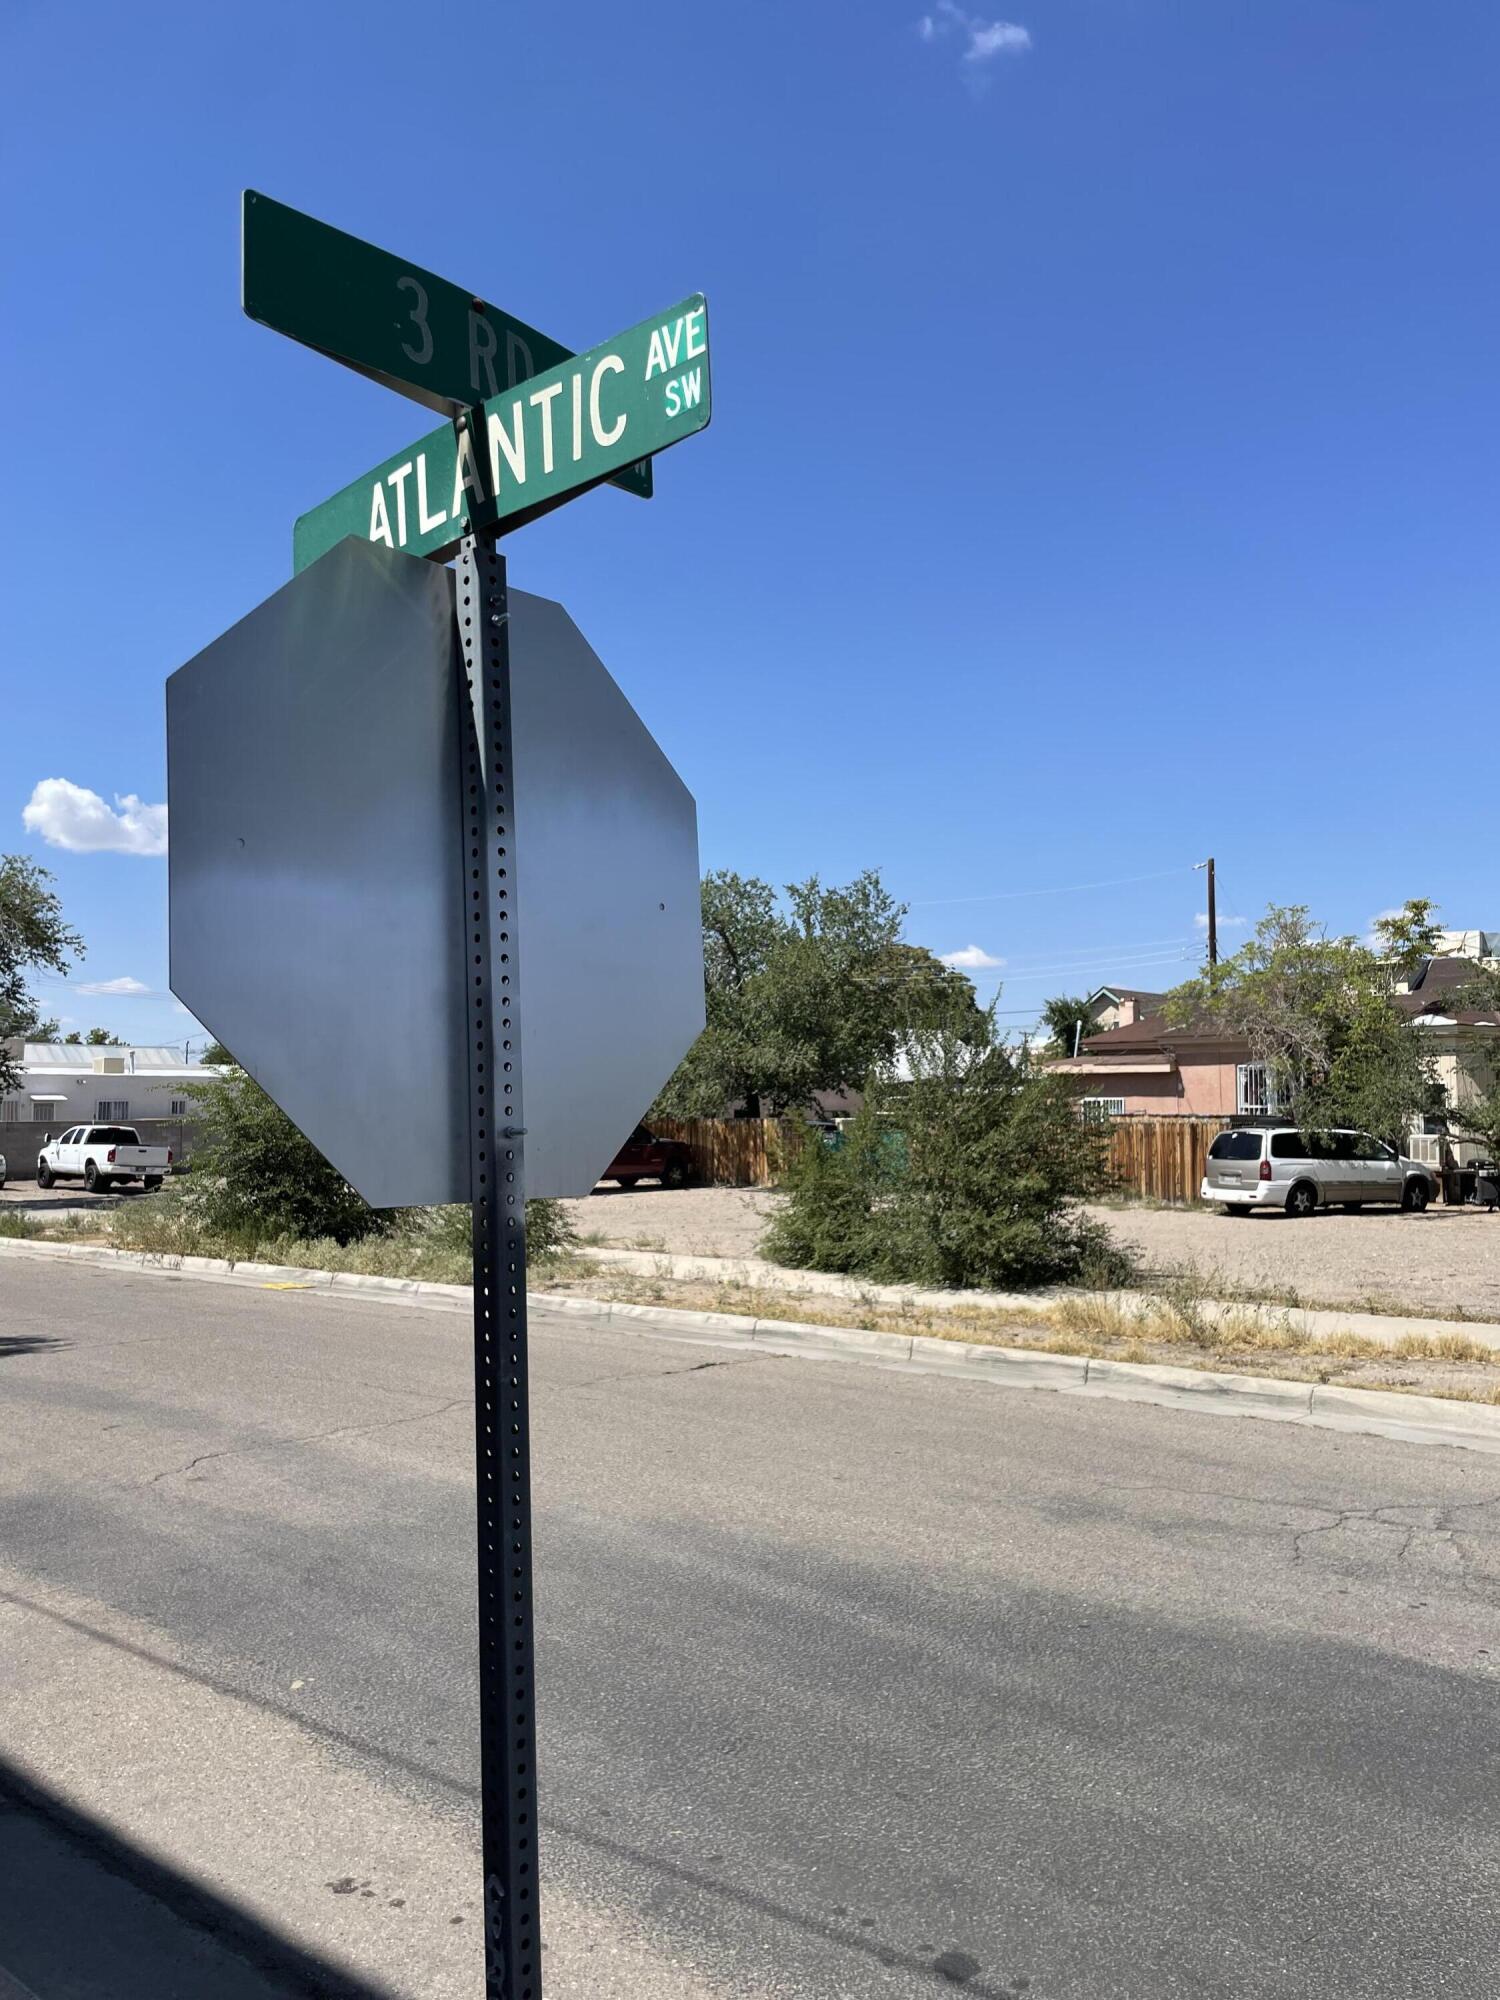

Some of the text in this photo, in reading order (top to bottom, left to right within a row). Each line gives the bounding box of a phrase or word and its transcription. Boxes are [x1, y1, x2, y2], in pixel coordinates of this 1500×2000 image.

[396, 276, 535, 398] 3 RD
[665, 366, 701, 417] SW
[369, 305, 706, 549] ATLANTIC AVE
